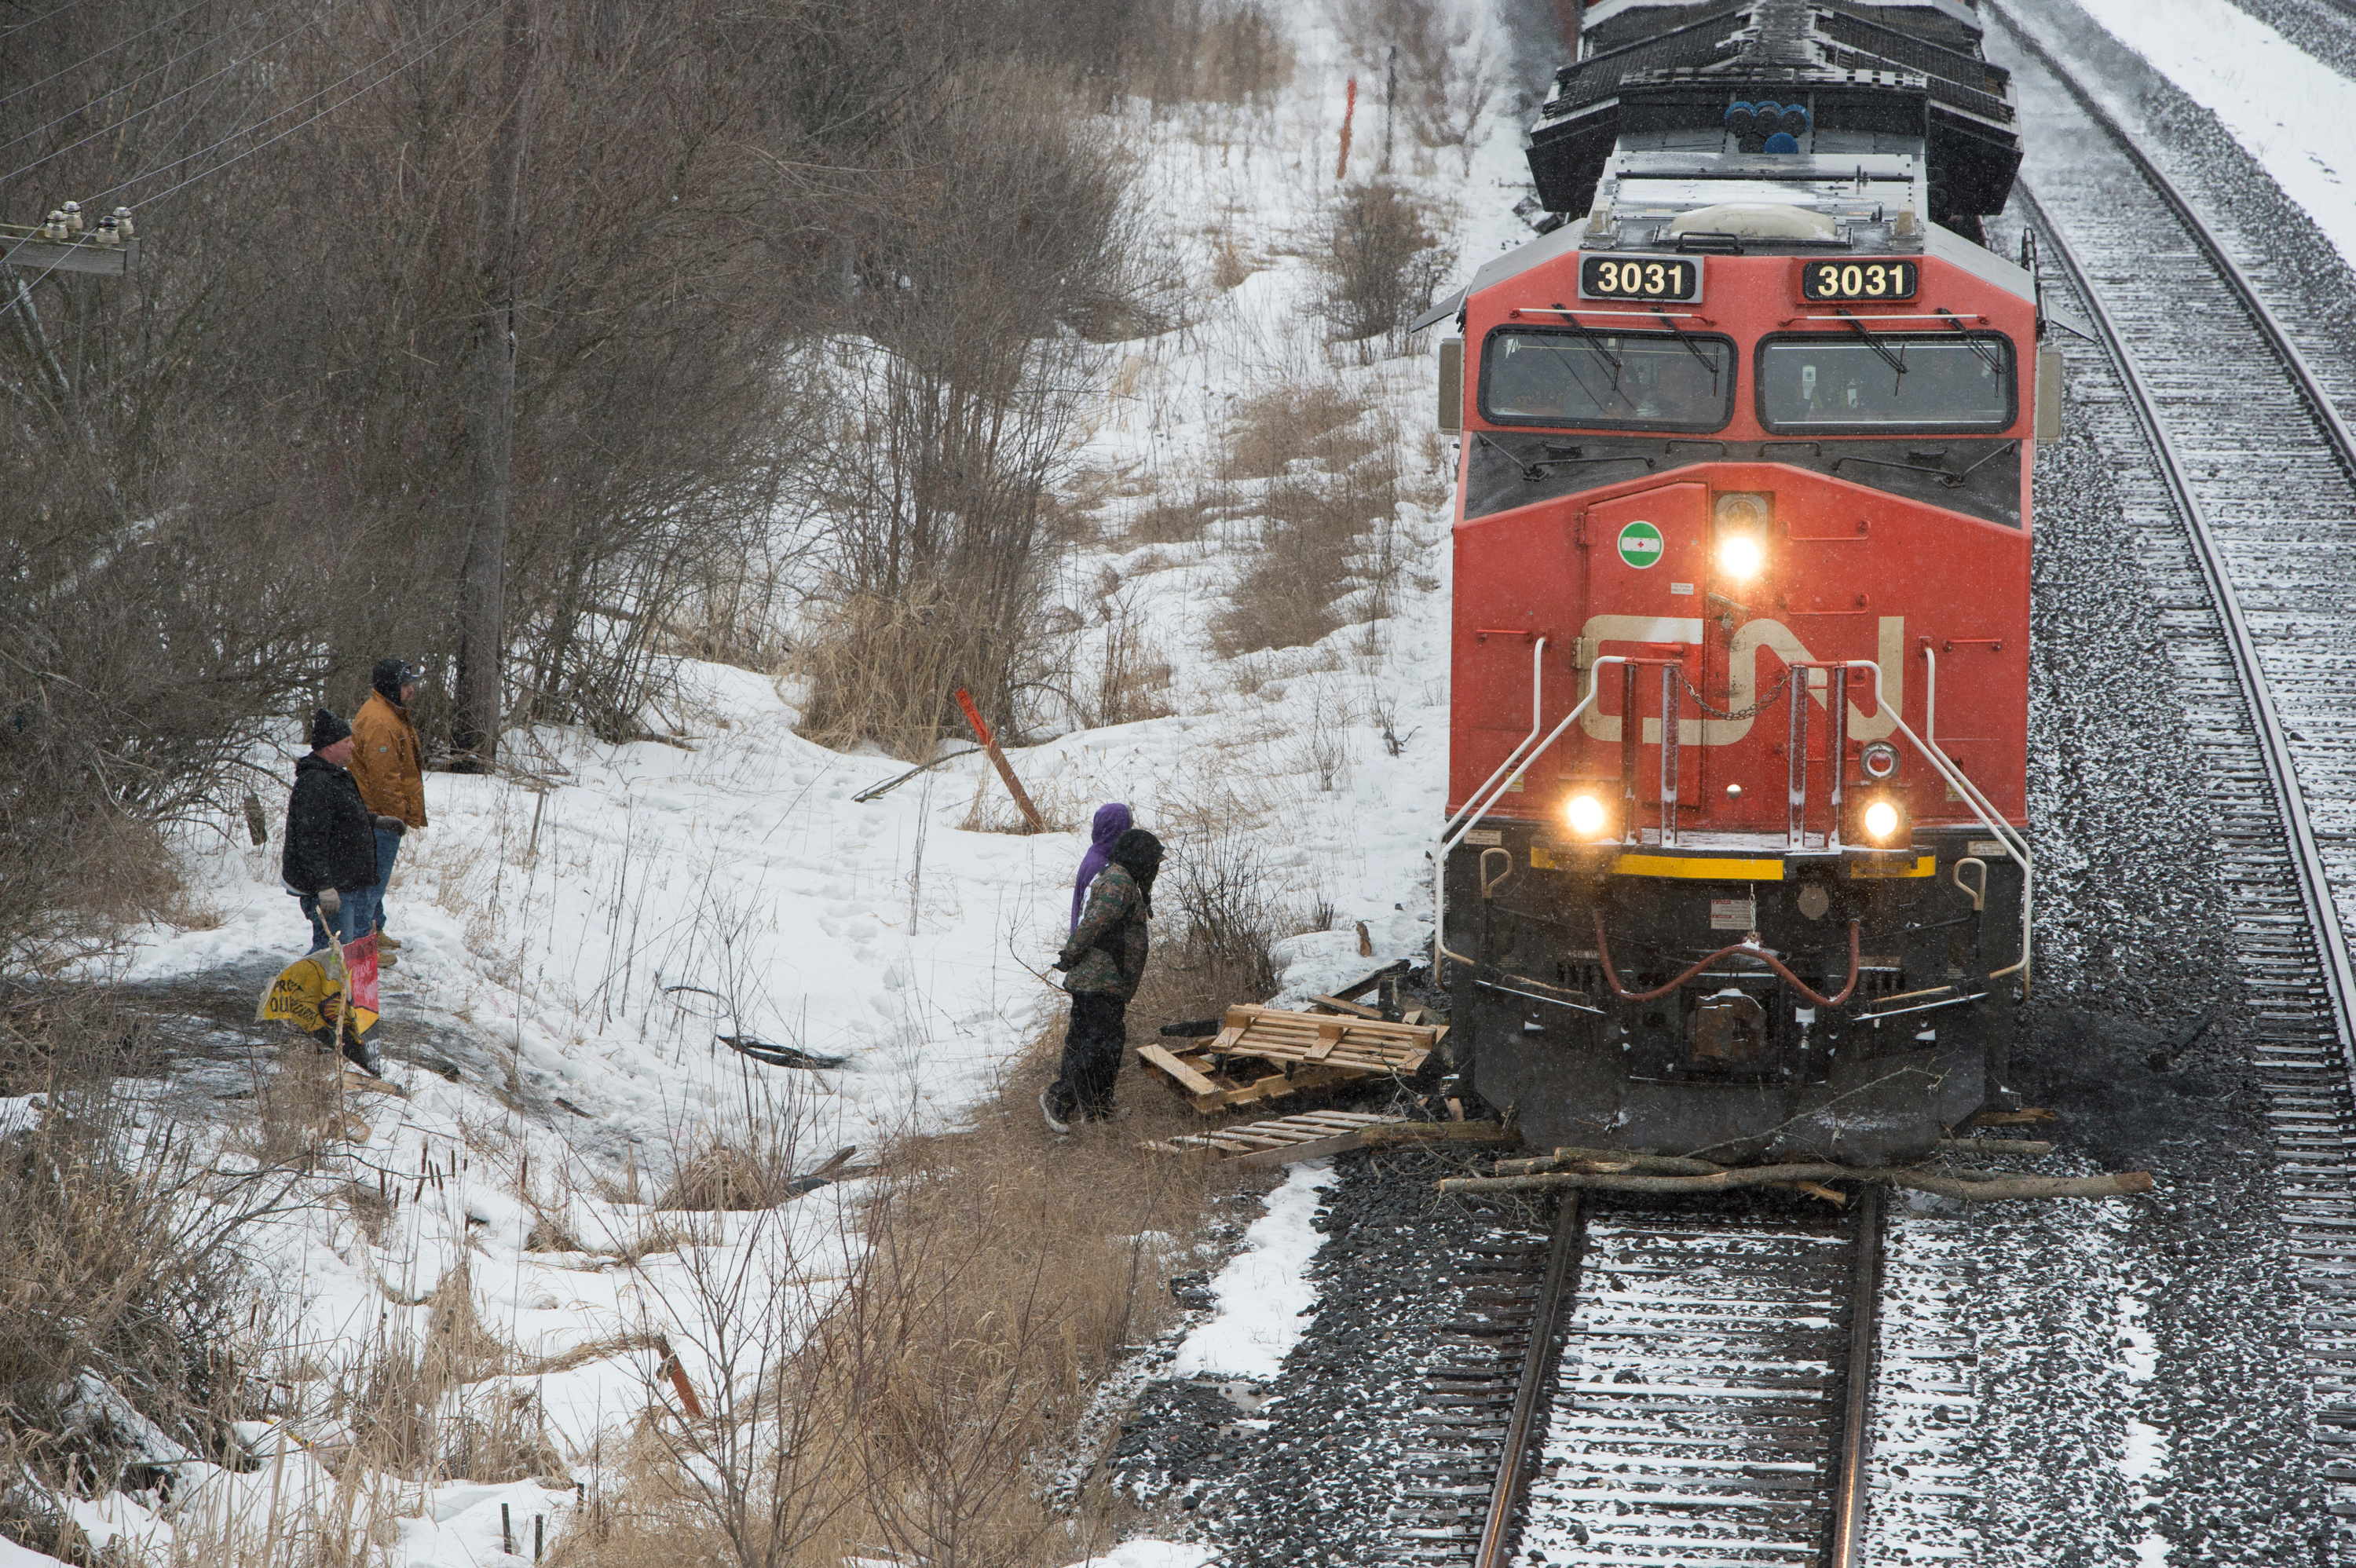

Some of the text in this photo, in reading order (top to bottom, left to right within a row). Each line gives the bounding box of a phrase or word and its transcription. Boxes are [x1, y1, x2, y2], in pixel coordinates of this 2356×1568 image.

[1597, 261, 1682, 294] 3031
[1817, 265, 1904, 296] 3031
[1577, 614, 1905, 747] CN
